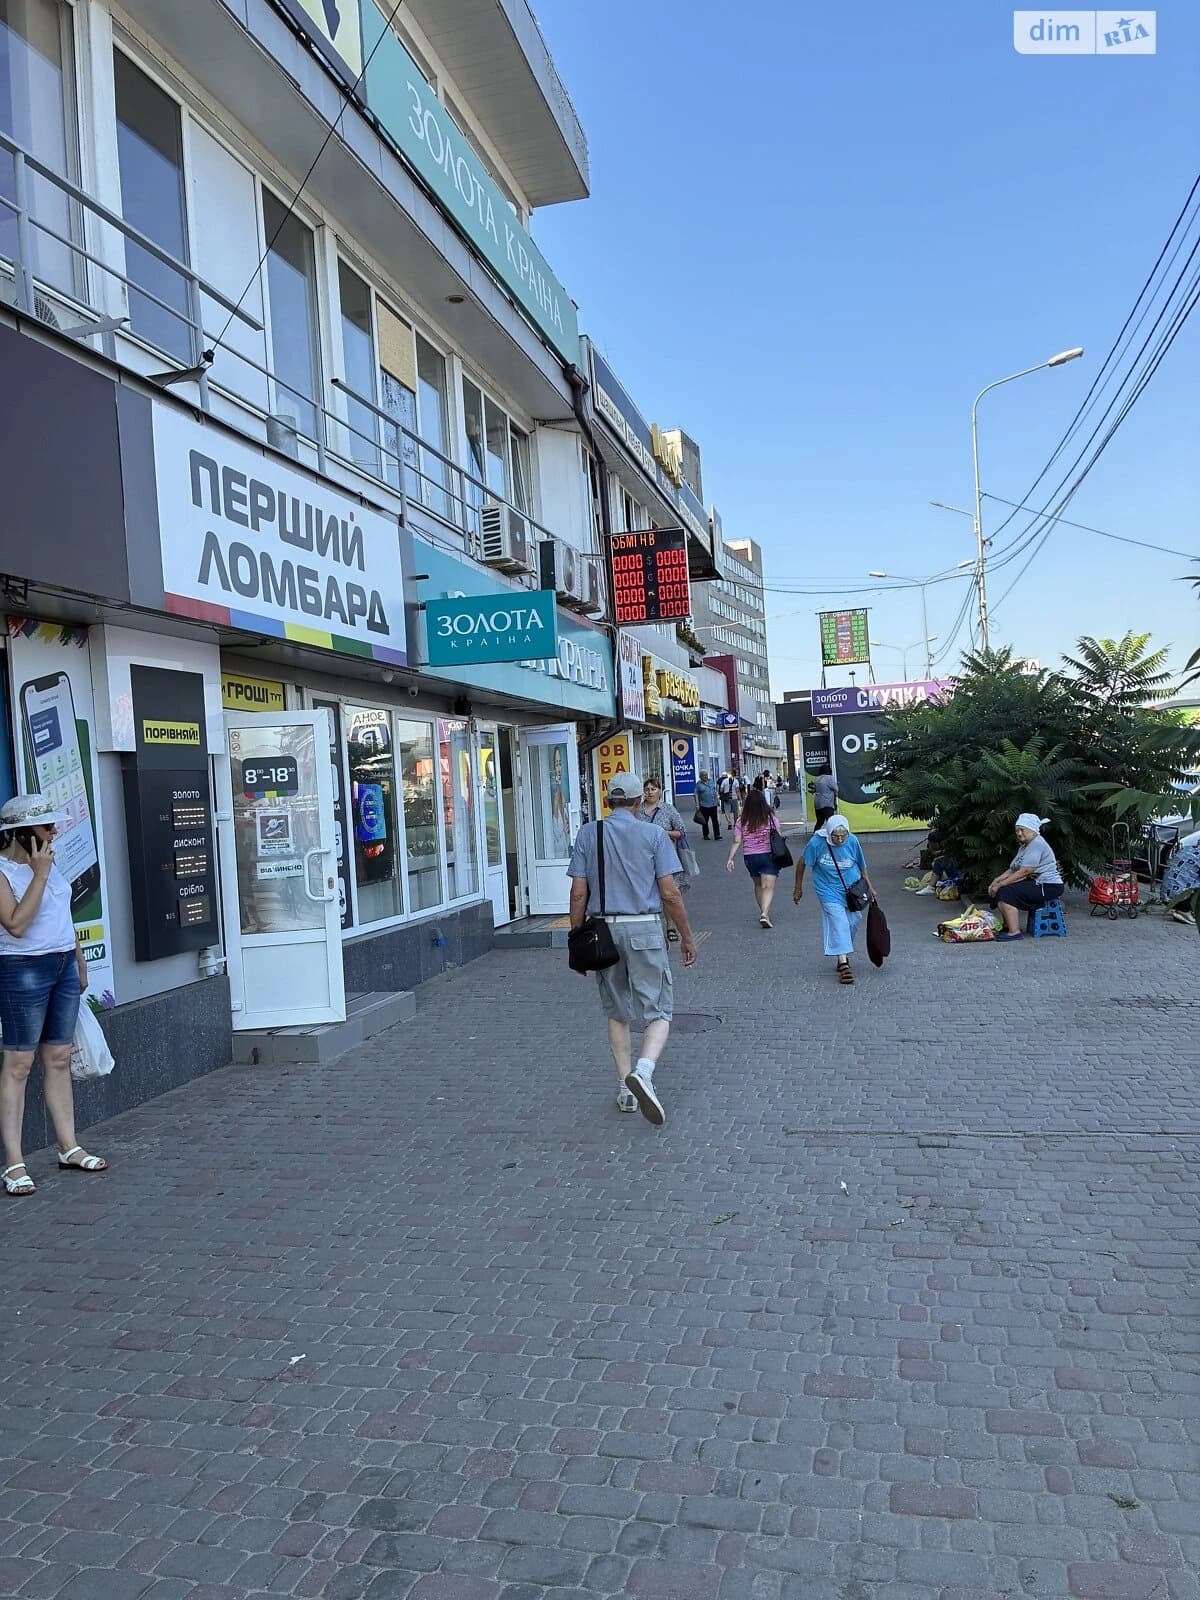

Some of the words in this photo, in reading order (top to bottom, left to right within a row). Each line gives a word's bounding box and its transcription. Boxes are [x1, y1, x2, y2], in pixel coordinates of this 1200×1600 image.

[406, 80, 499, 246] ЗОЛОТА
[189, 448, 366, 572] ПЕРШИЙ
[198, 530, 390, 636] ЛОМБАРД
[437, 608, 544, 636] ЗОЛОТА
[628, 666, 637, 688] 24
[227, 681, 269, 704] ГРОШІ
[270, 692, 282, 702] ТУТ
[815, 693, 848, 704] ЗОЛОТО
[856, 685, 927, 710] СКУПКА
[145, 726, 199, 741] ПОРІВНЯЙ!
[841, 732, 880, 754] ОБ
[179, 884, 205, 896] срібло
